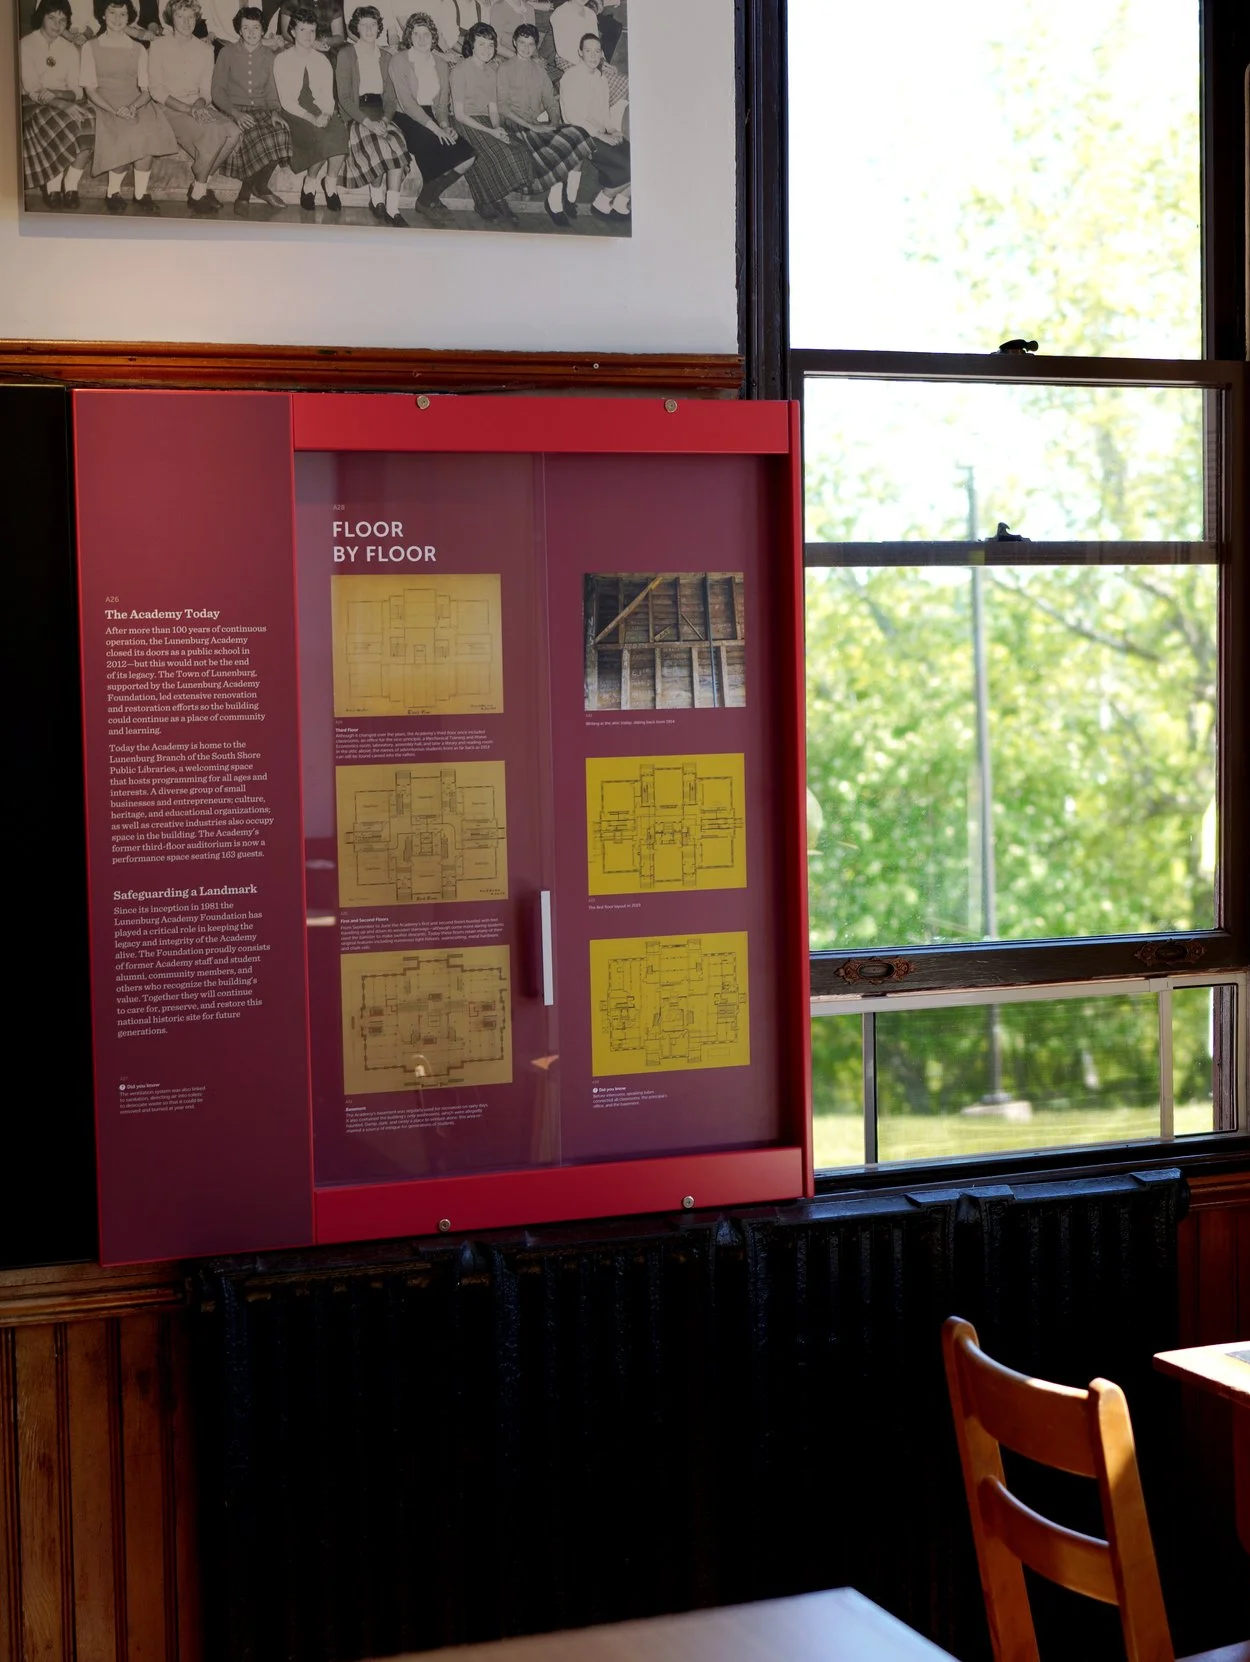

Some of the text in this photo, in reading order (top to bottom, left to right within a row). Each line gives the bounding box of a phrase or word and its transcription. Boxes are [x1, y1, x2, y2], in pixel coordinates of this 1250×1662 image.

[332, 521, 403, 537] FLOOR
[333, 546, 436, 562] BY FLOOR
[105, 608, 220, 622] The Academy Today
[105, 626, 128, 635] After
[151, 625, 171, 634] than
[172, 625, 188, 634] 100
[188, 626, 211, 636] years
[211, 624, 220, 633] of
[221, 624, 267, 633] continuous
[149, 636, 164, 645] the
[164, 636, 210, 647] Lunenburg
[210, 635, 248, 646] Academy
[149, 658, 166, 667] this
[166, 658, 193, 667] would
[193, 658, 208, 667] not
[208, 657, 219, 666] be
[219, 657, 233, 666] the
[234, 657, 249, 666] end
[106, 670, 116, 679] of
[116, 670, 128, 679] its
[157, 669, 175, 678] The
[175, 669, 200, 678] Town
[200, 669, 210, 678] of
[107, 679, 260, 692] supported by the Lunenburg Academy
[159, 691, 172, 700] led
[173, 691, 212, 700] extensive
[213, 690, 257, 699] renovation
[108, 704, 124, 713] and
[124, 703, 171, 712] restoration
[172, 702, 199, 712] efforts
[210, 702, 225, 711] the
[225, 701, 259, 713] building
[108, 715, 131, 724] could
[132, 714, 169, 723] continue
[186, 713, 209, 724] place
[209, 713, 218, 722] of
[219, 712, 265, 723] community
[108, 726, 125, 735] and
[110, 797, 156, 808] businesses
[156, 797, 172, 806] and
[148, 808, 164, 818] and
[164, 807, 213, 817] educational
[112, 852, 166, 865] performance
[166, 853, 190, 863] space
[190, 850, 221, 862] seating
[221, 849, 236, 859] 163
[113, 884, 258, 903] Safeguarding a Landmark
[113, 900, 234, 915] Since its inception in 1981 the
[114, 910, 262, 928] Lunenburg Academy Foundation has
